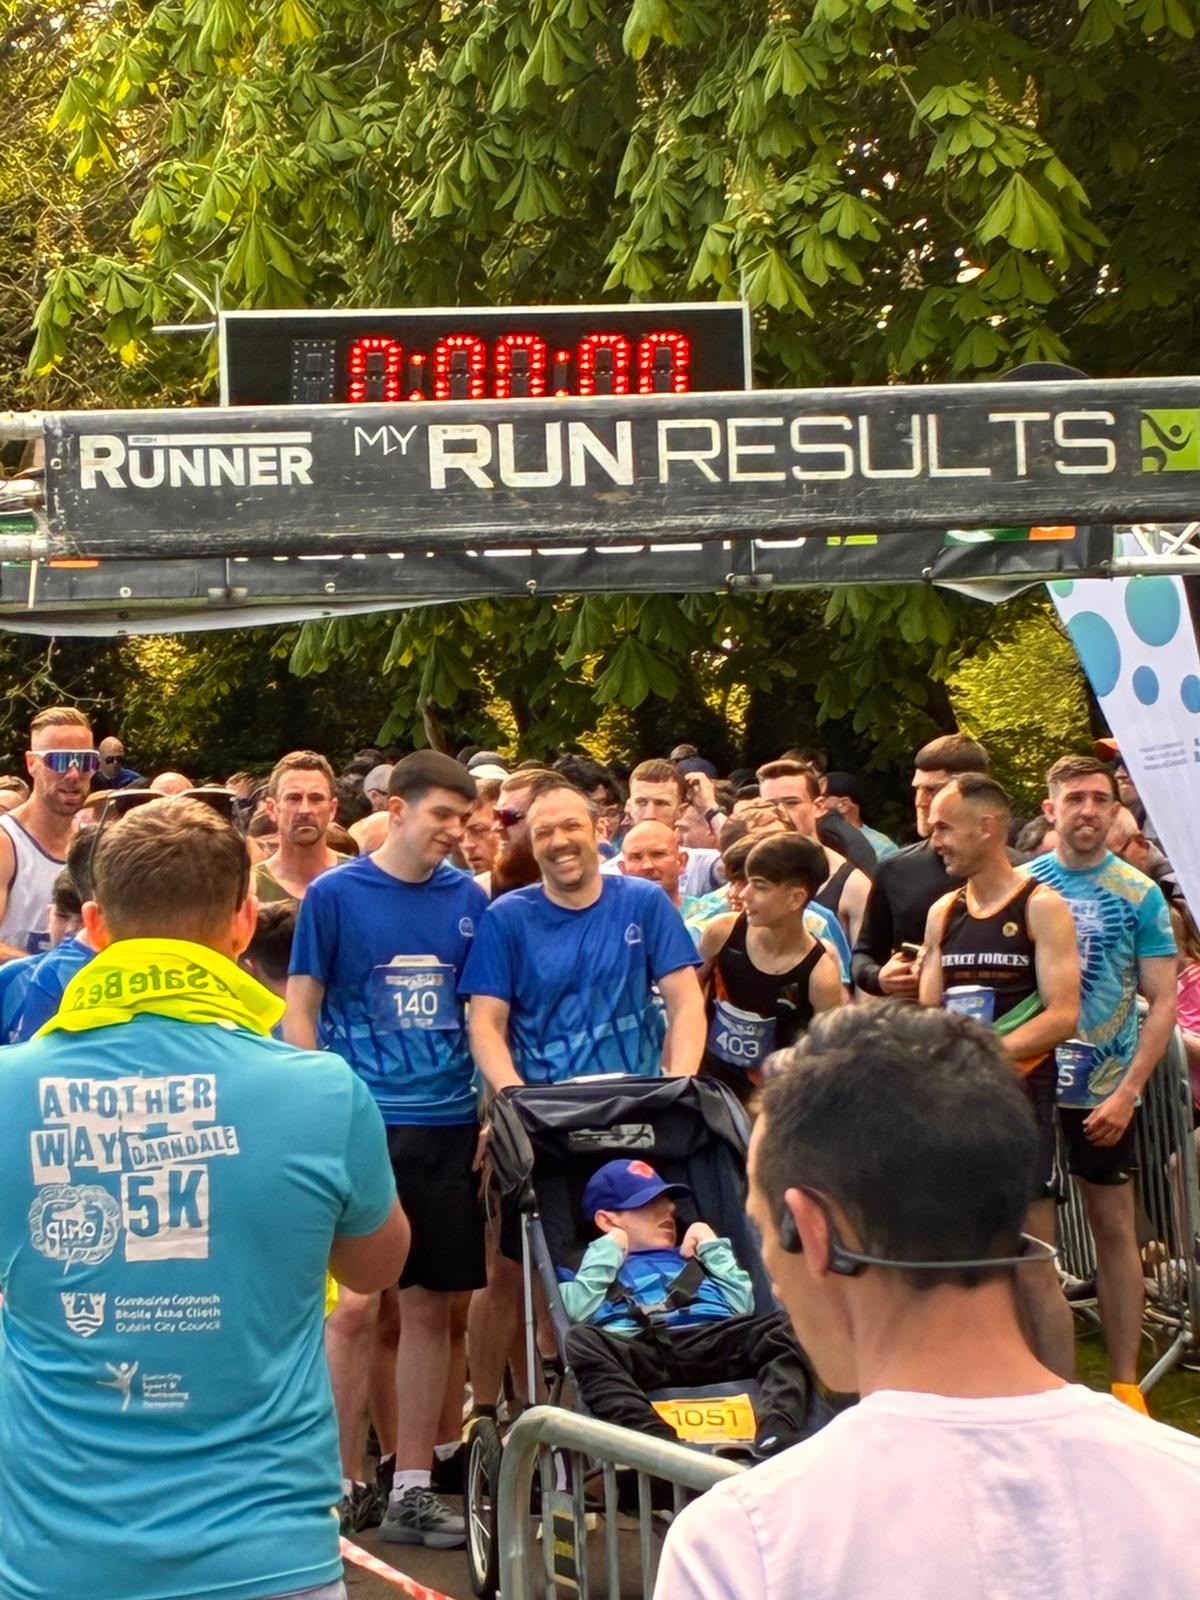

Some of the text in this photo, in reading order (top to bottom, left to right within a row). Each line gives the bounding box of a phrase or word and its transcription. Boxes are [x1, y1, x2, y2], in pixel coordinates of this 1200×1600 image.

[348, 331, 690, 402] 0:00:00
[79, 434, 314, 489] RUNNER
[354, 410, 1117, 489] MY RUN RESULTS
[977, 952, 1030, 967] FORCES
[393, 991, 438, 1017] 140
[716, 1031, 759, 1058] 403
[43, 1078, 212, 1119] ANOTHER
[35, 1126, 235, 1167] WAY DARNDALE
[127, 1169, 204, 1237] 5K
[671, 1408, 738, 1427] 1051
